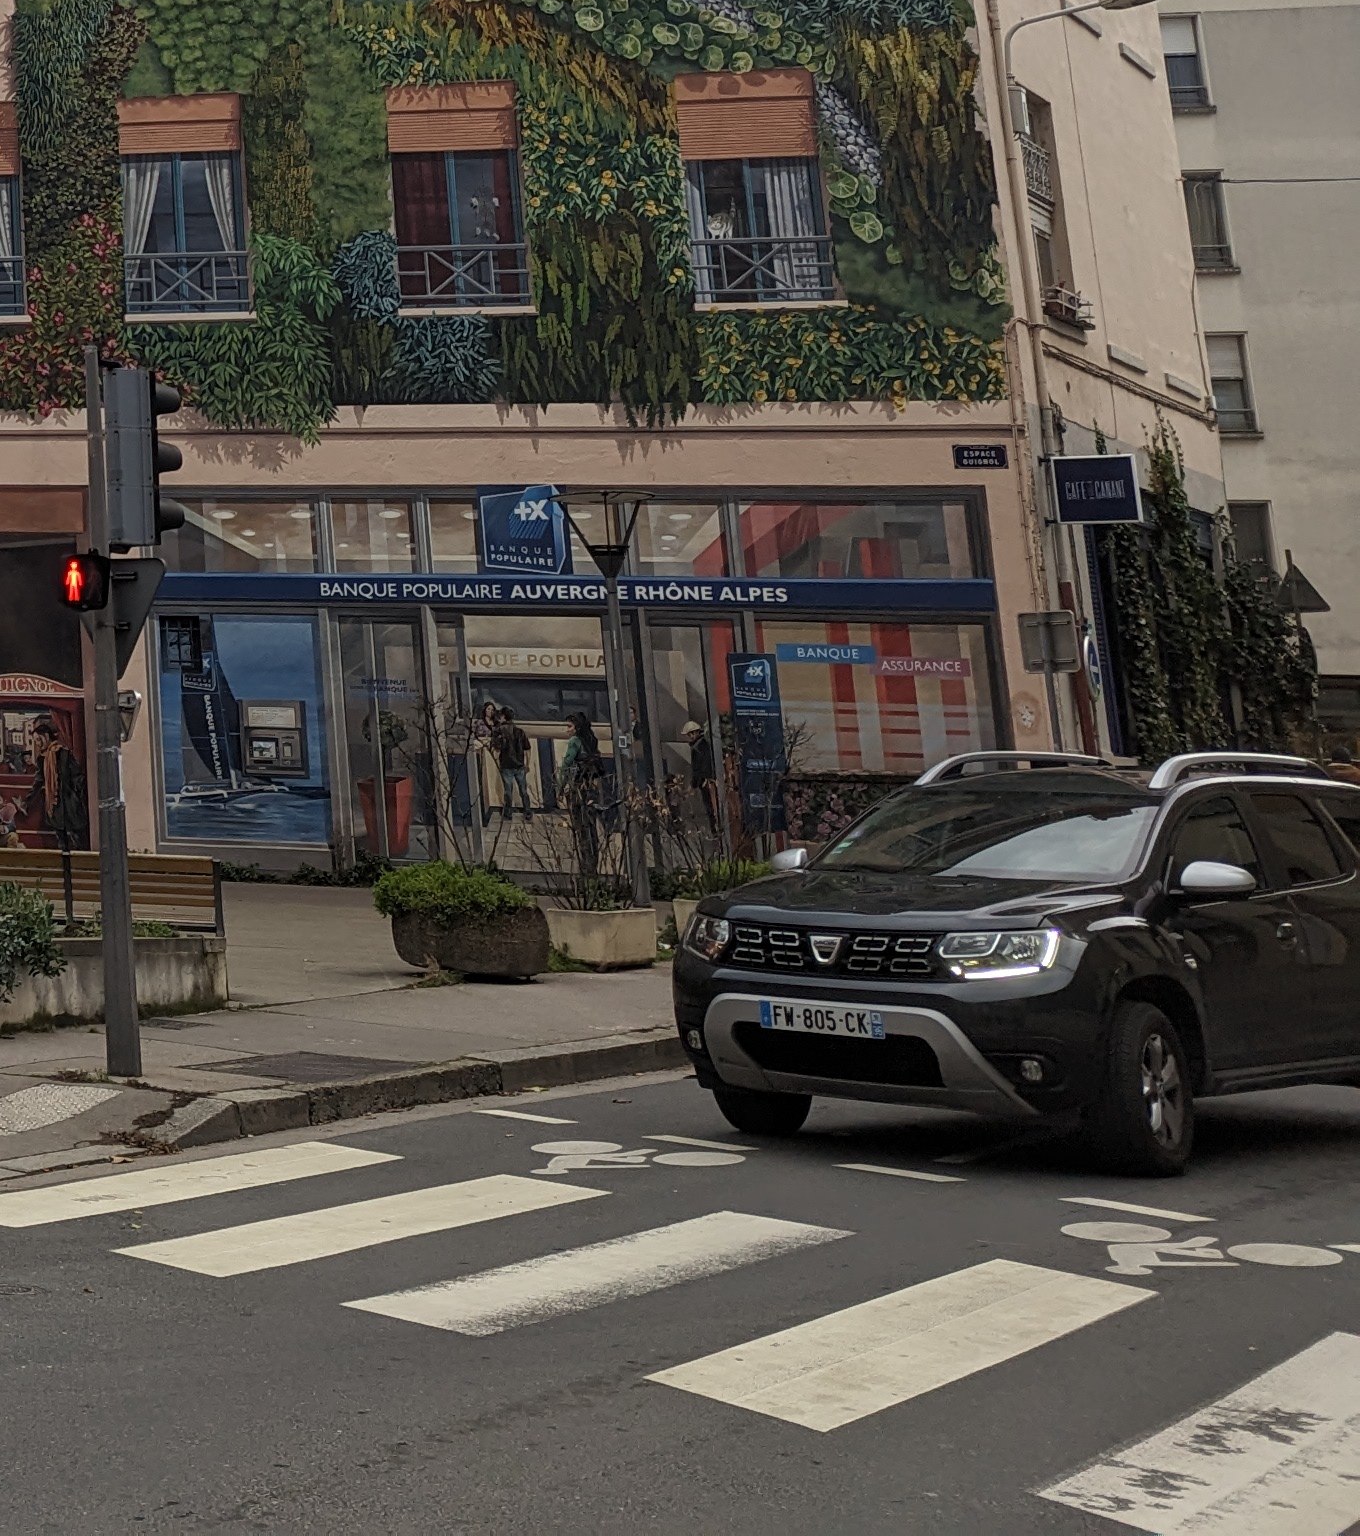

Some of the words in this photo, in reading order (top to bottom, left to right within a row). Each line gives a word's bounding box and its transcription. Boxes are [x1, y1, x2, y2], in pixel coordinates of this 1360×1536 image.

[963, 450, 996, 458] ESPACE
[962, 458, 1000, 466] GUIGNOL
[489, 544, 553, 556] BANQUE
[490, 553, 554, 567] POPULAIRE
[319, 582, 397, 600] BANQUE
[403, 584, 502, 600] POPULAIRE
[635, 582, 713, 601] RHÔNE
[719, 587, 788, 602] ALPES
[796, 647, 860, 660] BANQUE
[438, 653, 520, 669] BNQUE
[527, 654, 605, 669] POPULA
[881, 660, 962, 674] ASSURANCE
[203, 694, 216, 731] BANQUE
[209, 732, 223, 780] POPULAIRE
